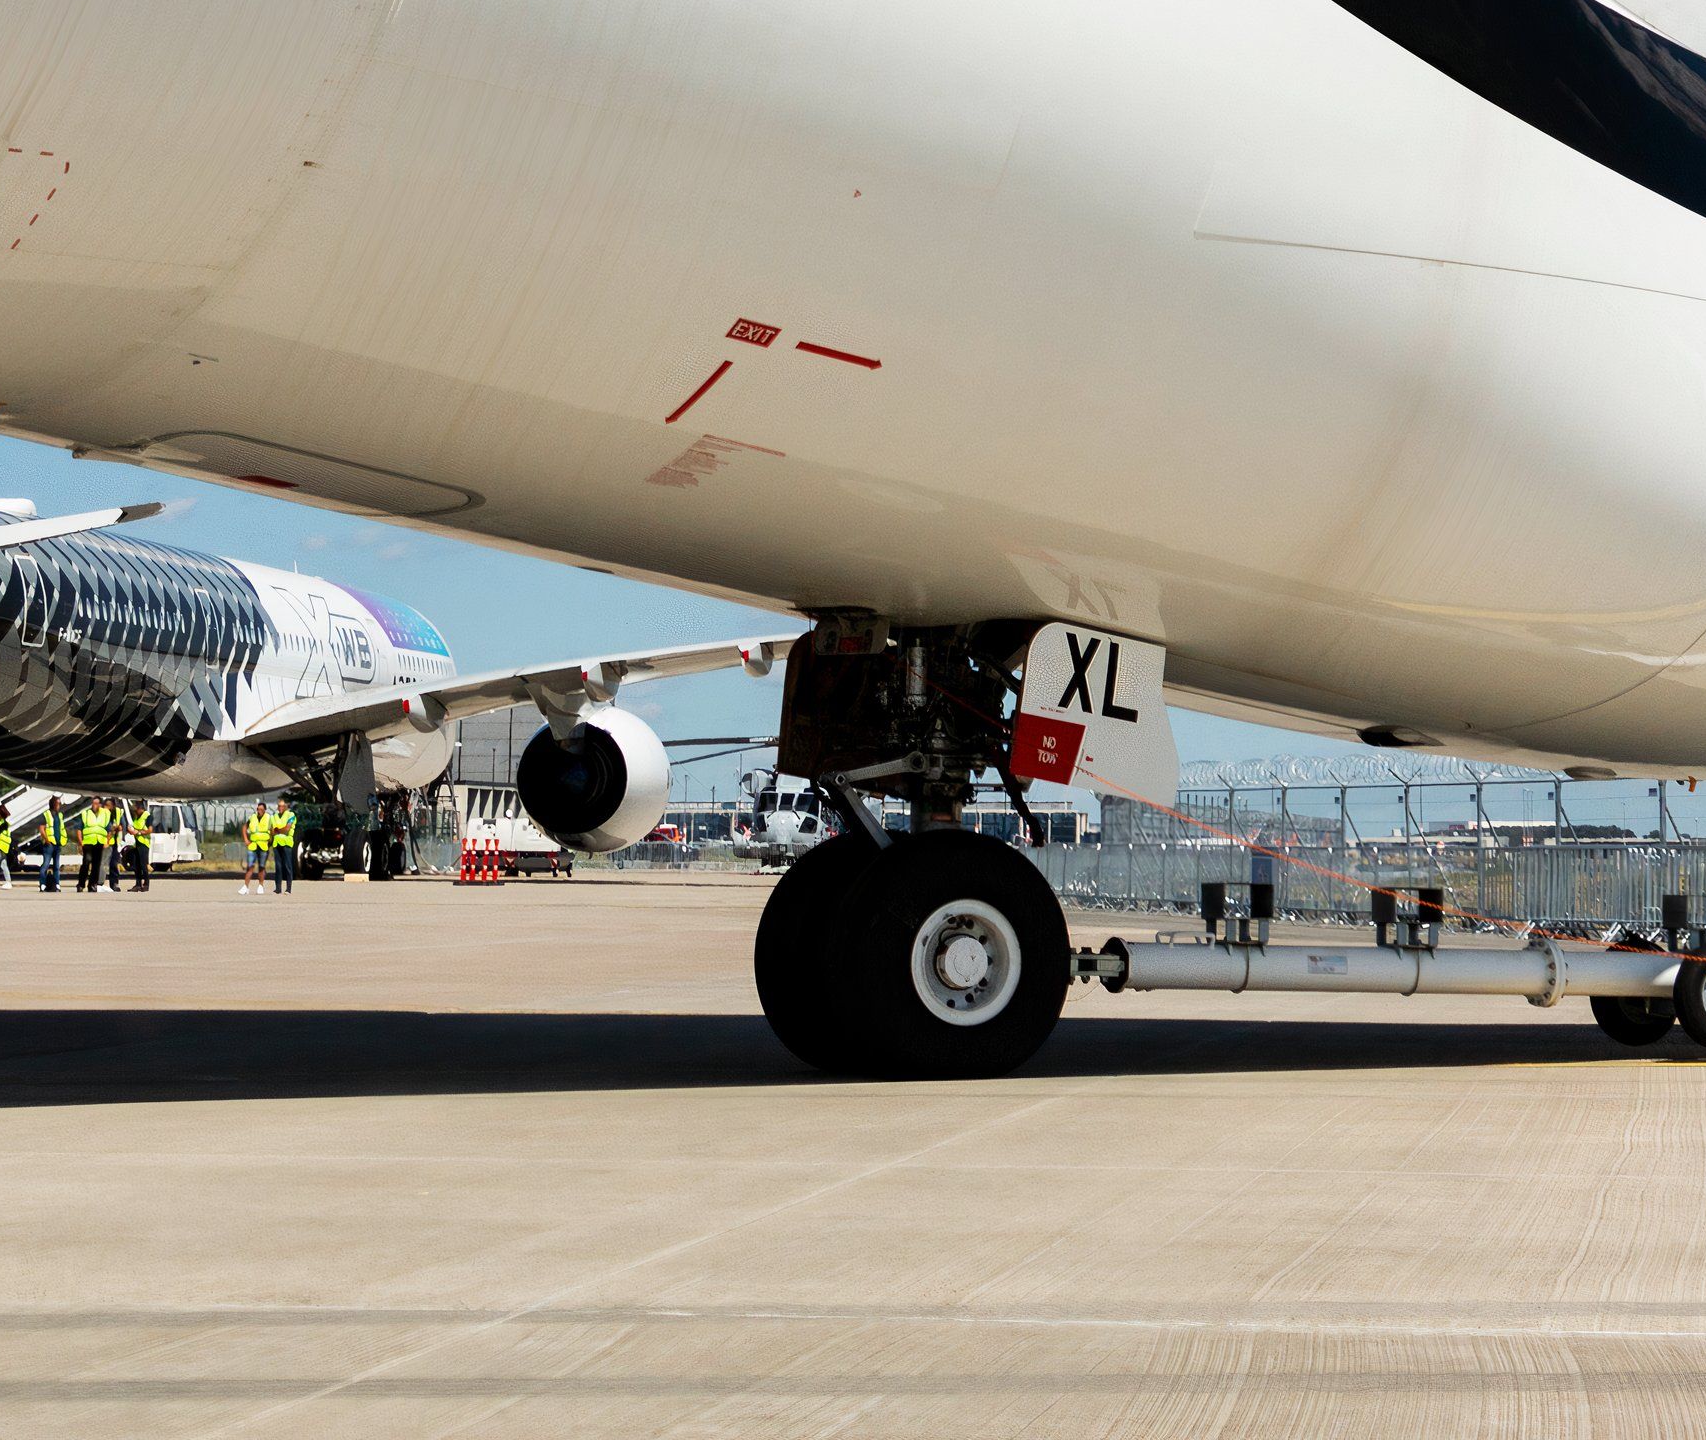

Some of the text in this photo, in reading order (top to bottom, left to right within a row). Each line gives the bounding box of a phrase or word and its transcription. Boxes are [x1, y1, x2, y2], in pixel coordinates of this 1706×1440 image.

[732, 322, 775, 343] EXIT
[1058, 632, 1138, 723] XL
[1042, 735, 1057, 749] NO
